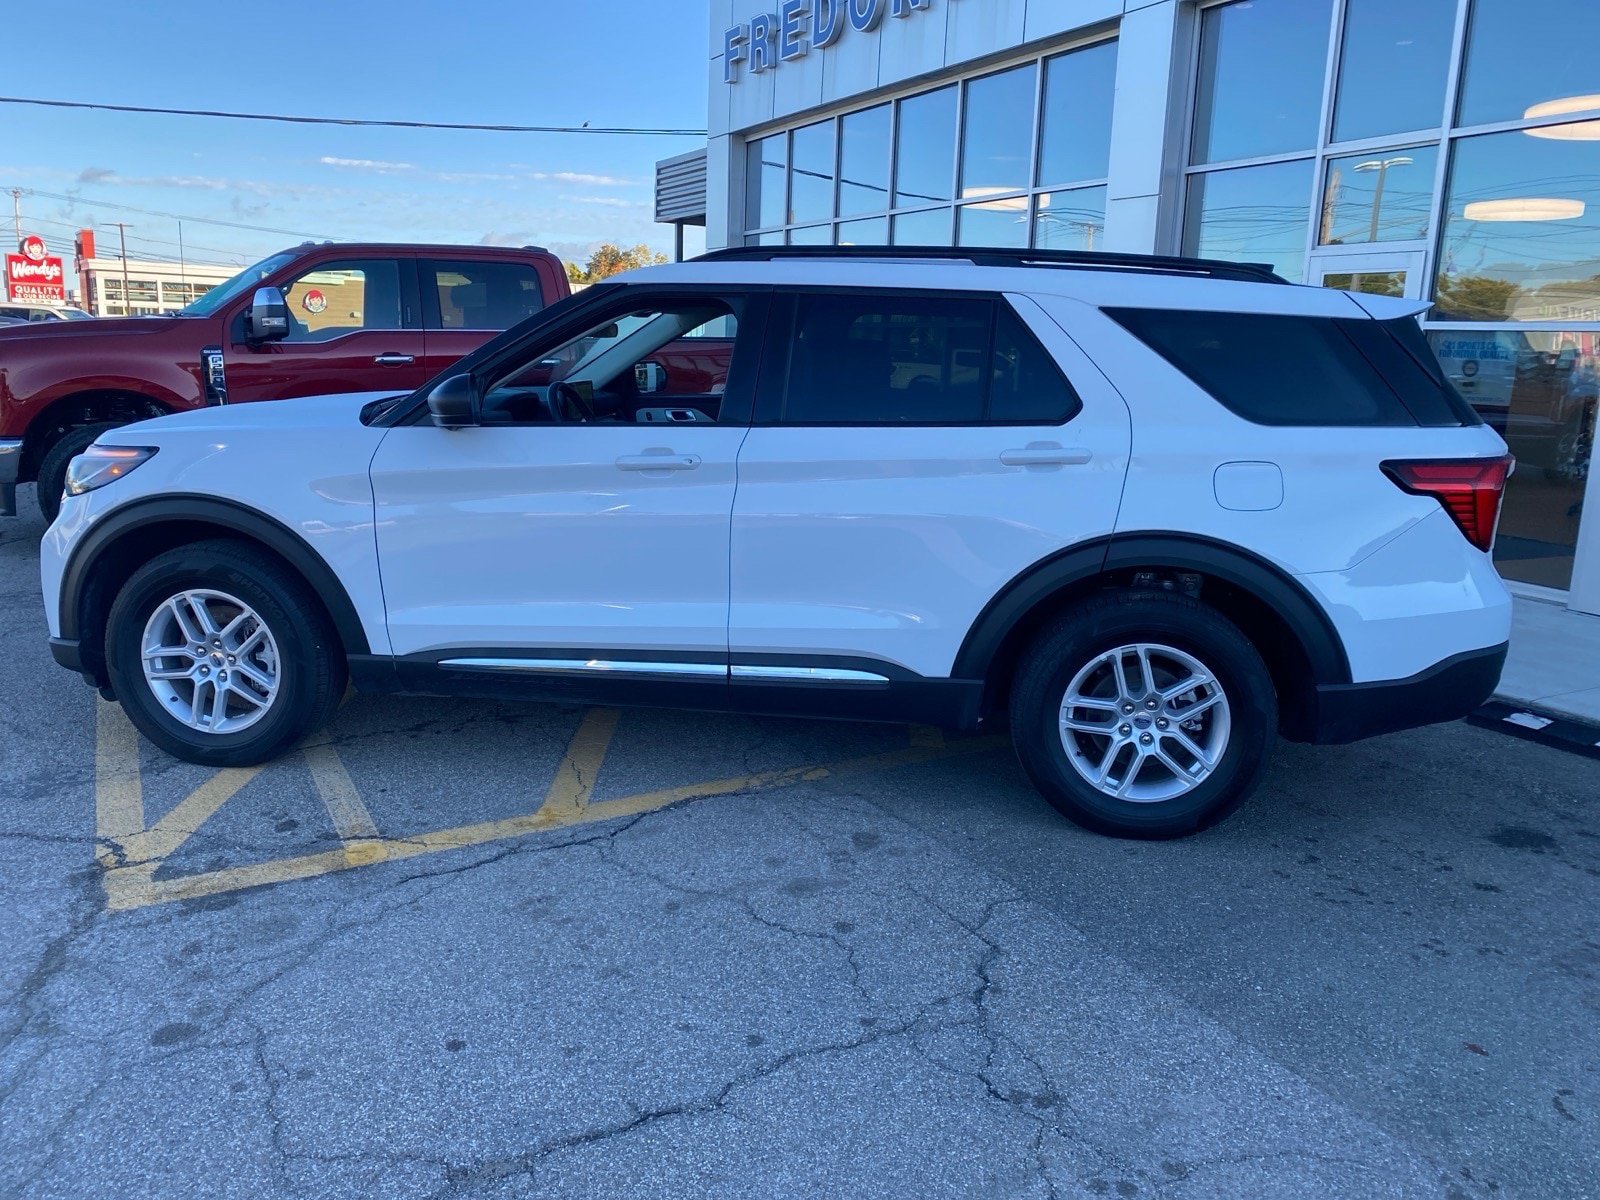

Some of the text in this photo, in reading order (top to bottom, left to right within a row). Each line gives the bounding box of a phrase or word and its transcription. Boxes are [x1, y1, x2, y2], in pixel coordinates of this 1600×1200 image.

[724, 0, 929, 83] FREDO
[11, 260, 61, 280] Wendy's
[14, 285, 60, 295] QUALITY
